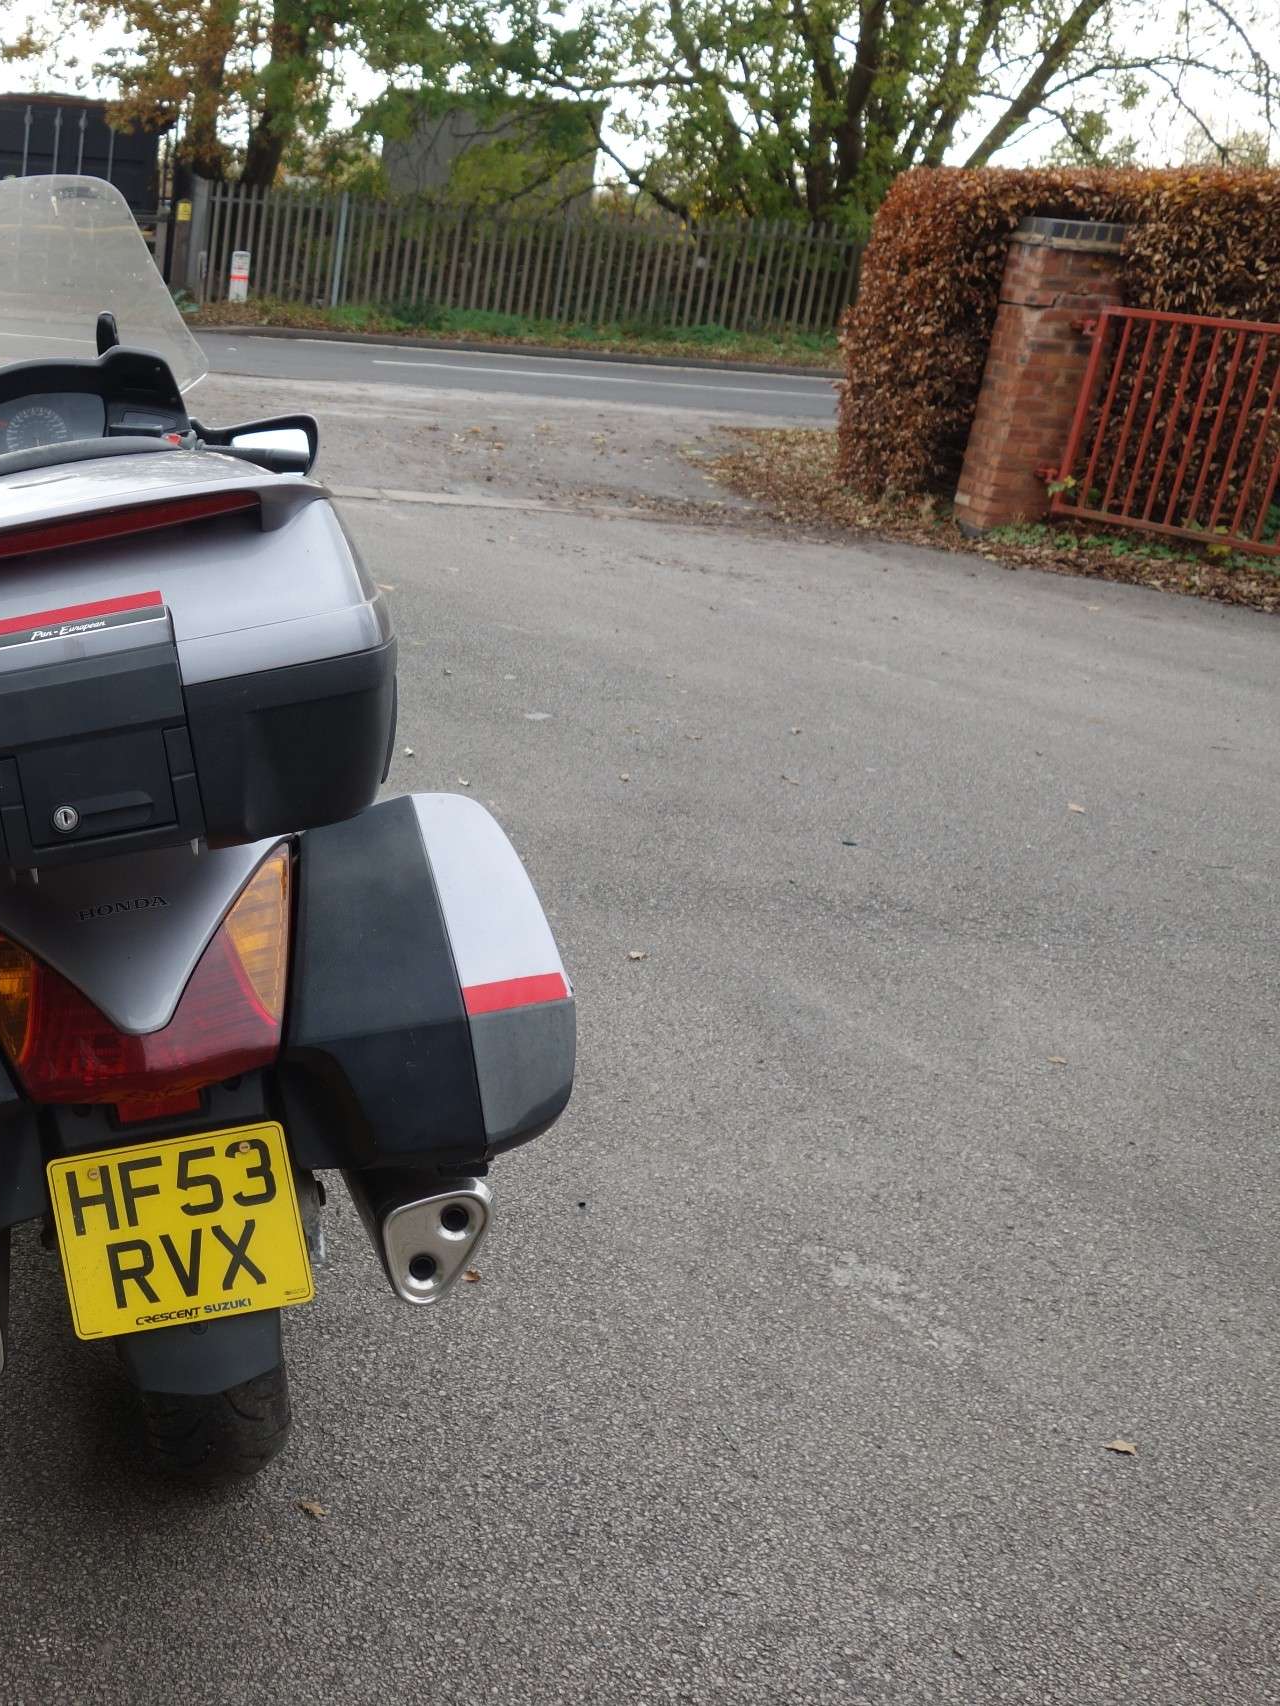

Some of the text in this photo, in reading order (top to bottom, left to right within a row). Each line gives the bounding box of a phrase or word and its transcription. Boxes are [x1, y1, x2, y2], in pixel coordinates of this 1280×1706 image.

[78, 895, 168, 921] HONDA
[65, 1138, 277, 1237] HF53
[106, 1218, 267, 1310] RVX
[135, 1297, 252, 1326] CRESCENT SUZUKI
